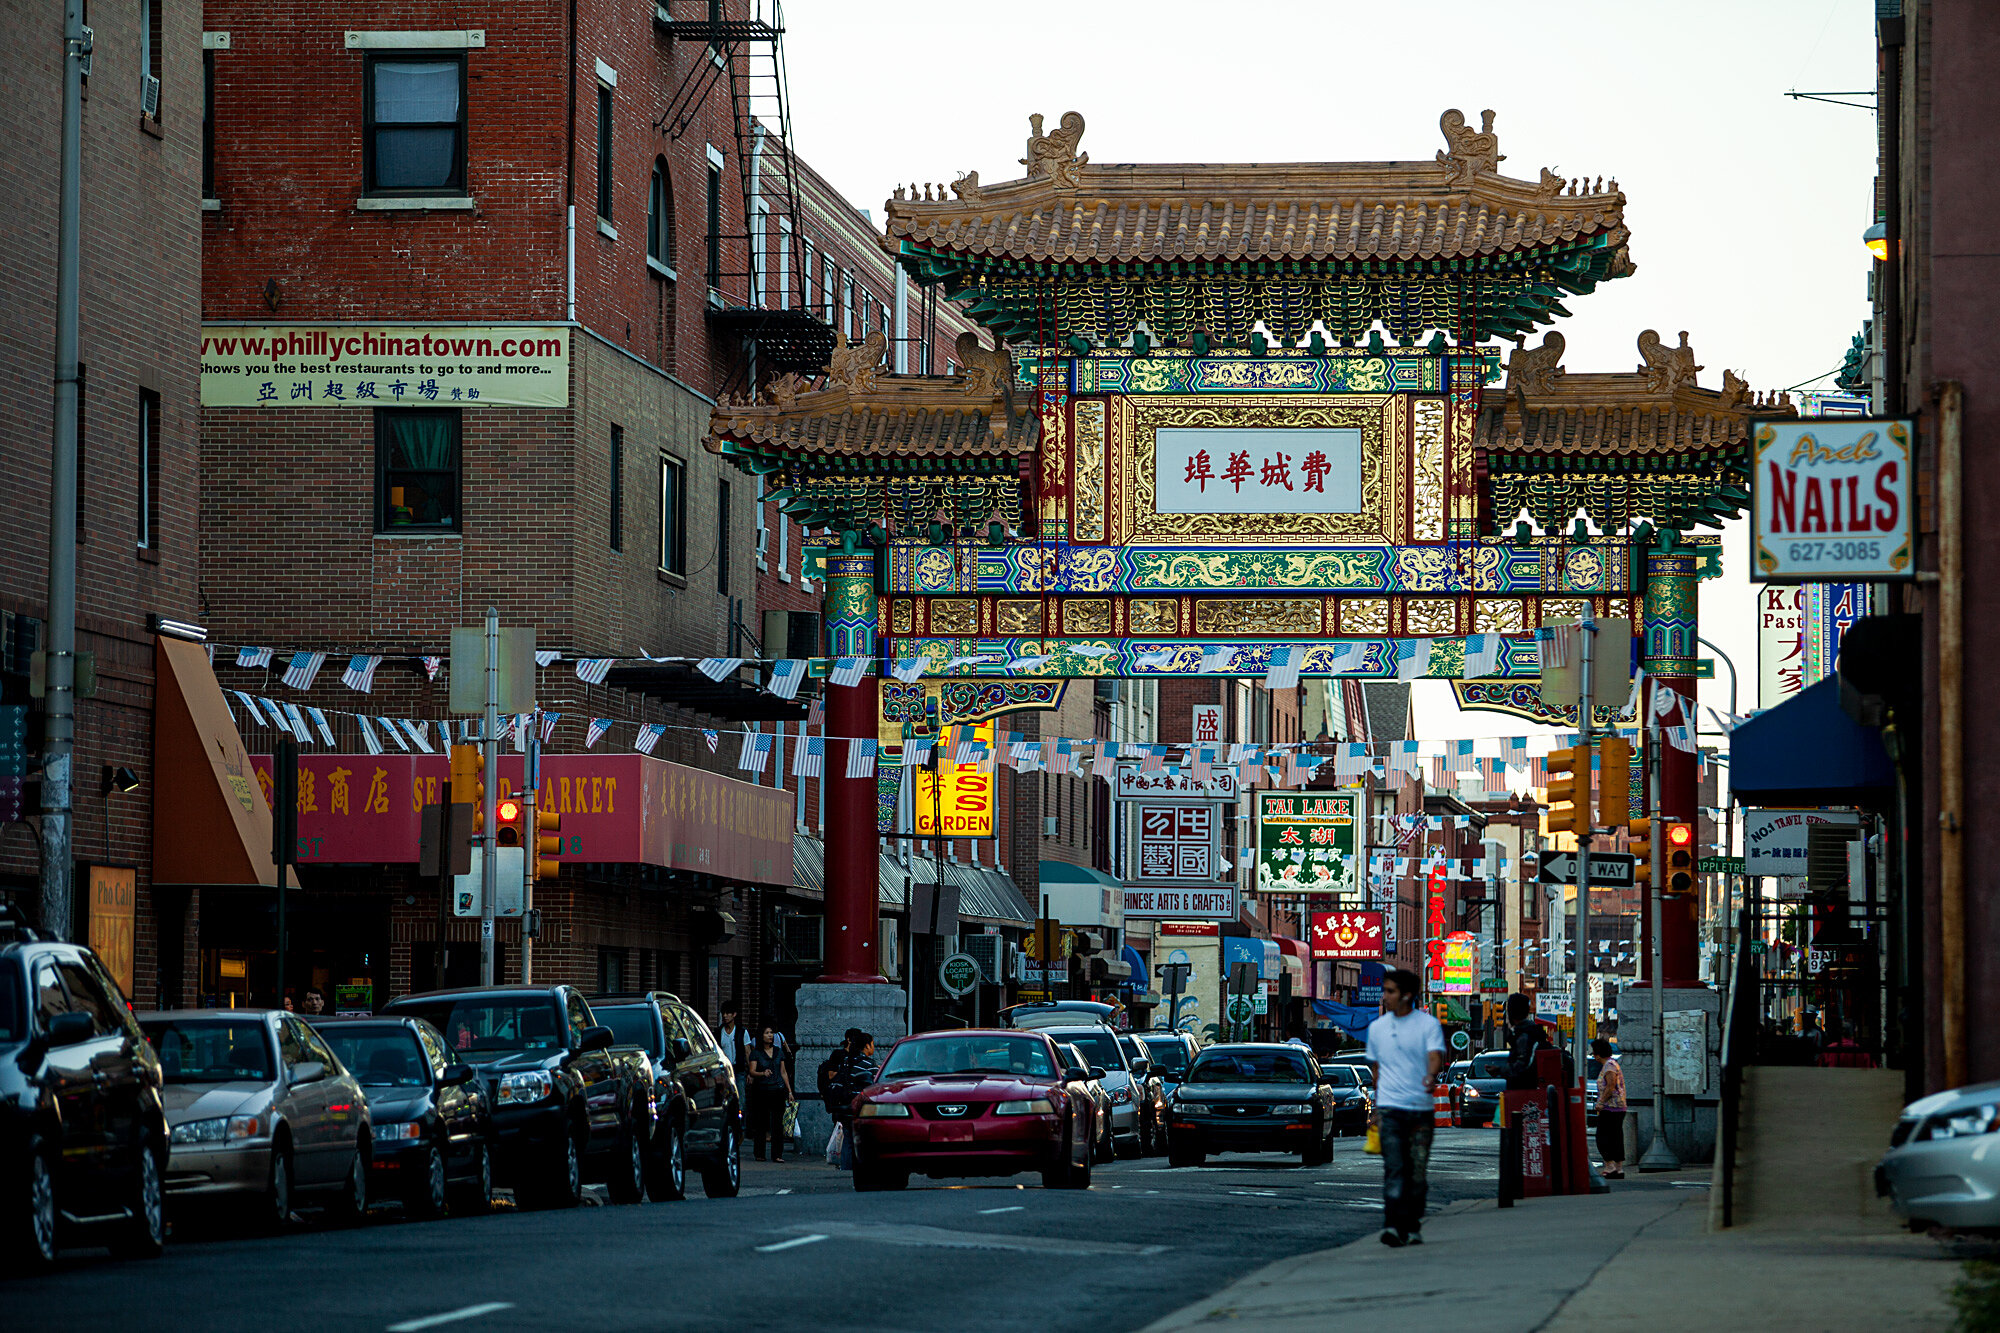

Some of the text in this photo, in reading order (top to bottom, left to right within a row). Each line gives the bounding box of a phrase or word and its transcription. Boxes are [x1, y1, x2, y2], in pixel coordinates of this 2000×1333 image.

[245, 365, 270, 376] you
[273, 363, 297, 374] the
[300, 363, 331, 374] best
[334, 364, 415, 374] restaurants
[419, 365, 433, 375] to
[437, 367, 454, 377] go
[458, 365, 473, 375] to
[477, 364, 502, 375] and
[505, 366, 552, 375] more...
[1788, 431, 1881, 468] Arch
[1184, 449, 1332, 494] 埠華城費
[1769, 459, 1899, 533] NAILS
[1789, 541, 1880, 562] 627-3085
[1196, 709, 1218, 741] 盛
[1266, 799, 1350, 815] TAI LAKE
[918, 815, 990, 830] GARDEN
[1751, 822, 1776, 843] NO.1
[1774, 814, 1802, 829] TRAVEL
[1279, 826, 1336, 845] 太湖
[1598, 863, 1625, 876] WAY
[98, 881, 132, 905] Pho Cali
[1124, 893, 1154, 910] HINESE
[1157, 893, 1179, 910] ARTS
[1183, 894, 1189, 910] &
[1192, 893, 1225, 911] CRAFTS
